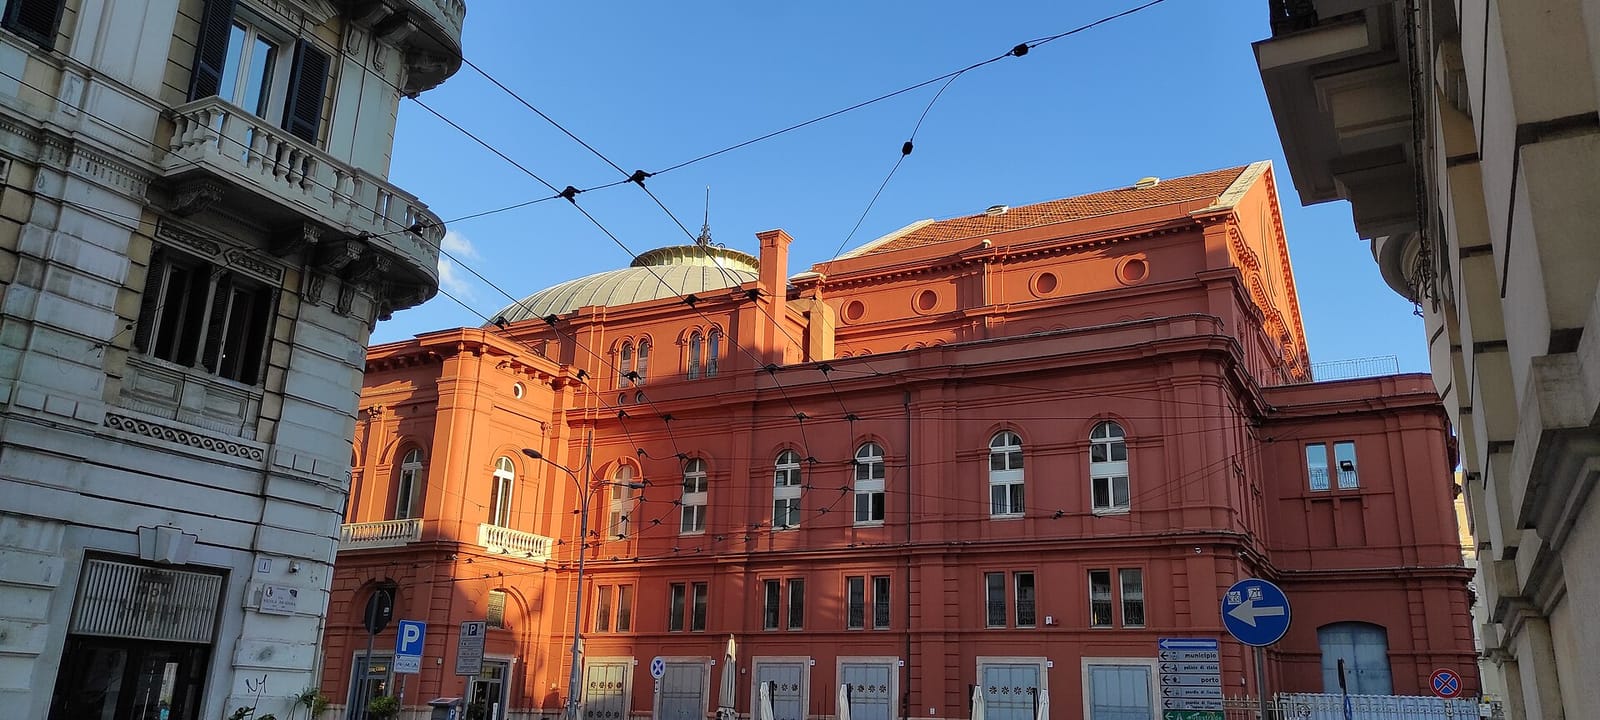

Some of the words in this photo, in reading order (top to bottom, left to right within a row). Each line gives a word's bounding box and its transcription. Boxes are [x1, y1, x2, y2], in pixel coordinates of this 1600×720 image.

[469, 624, 476, 635] P
[402, 624, 420, 651] P
[449, 708, 456, 719] P
